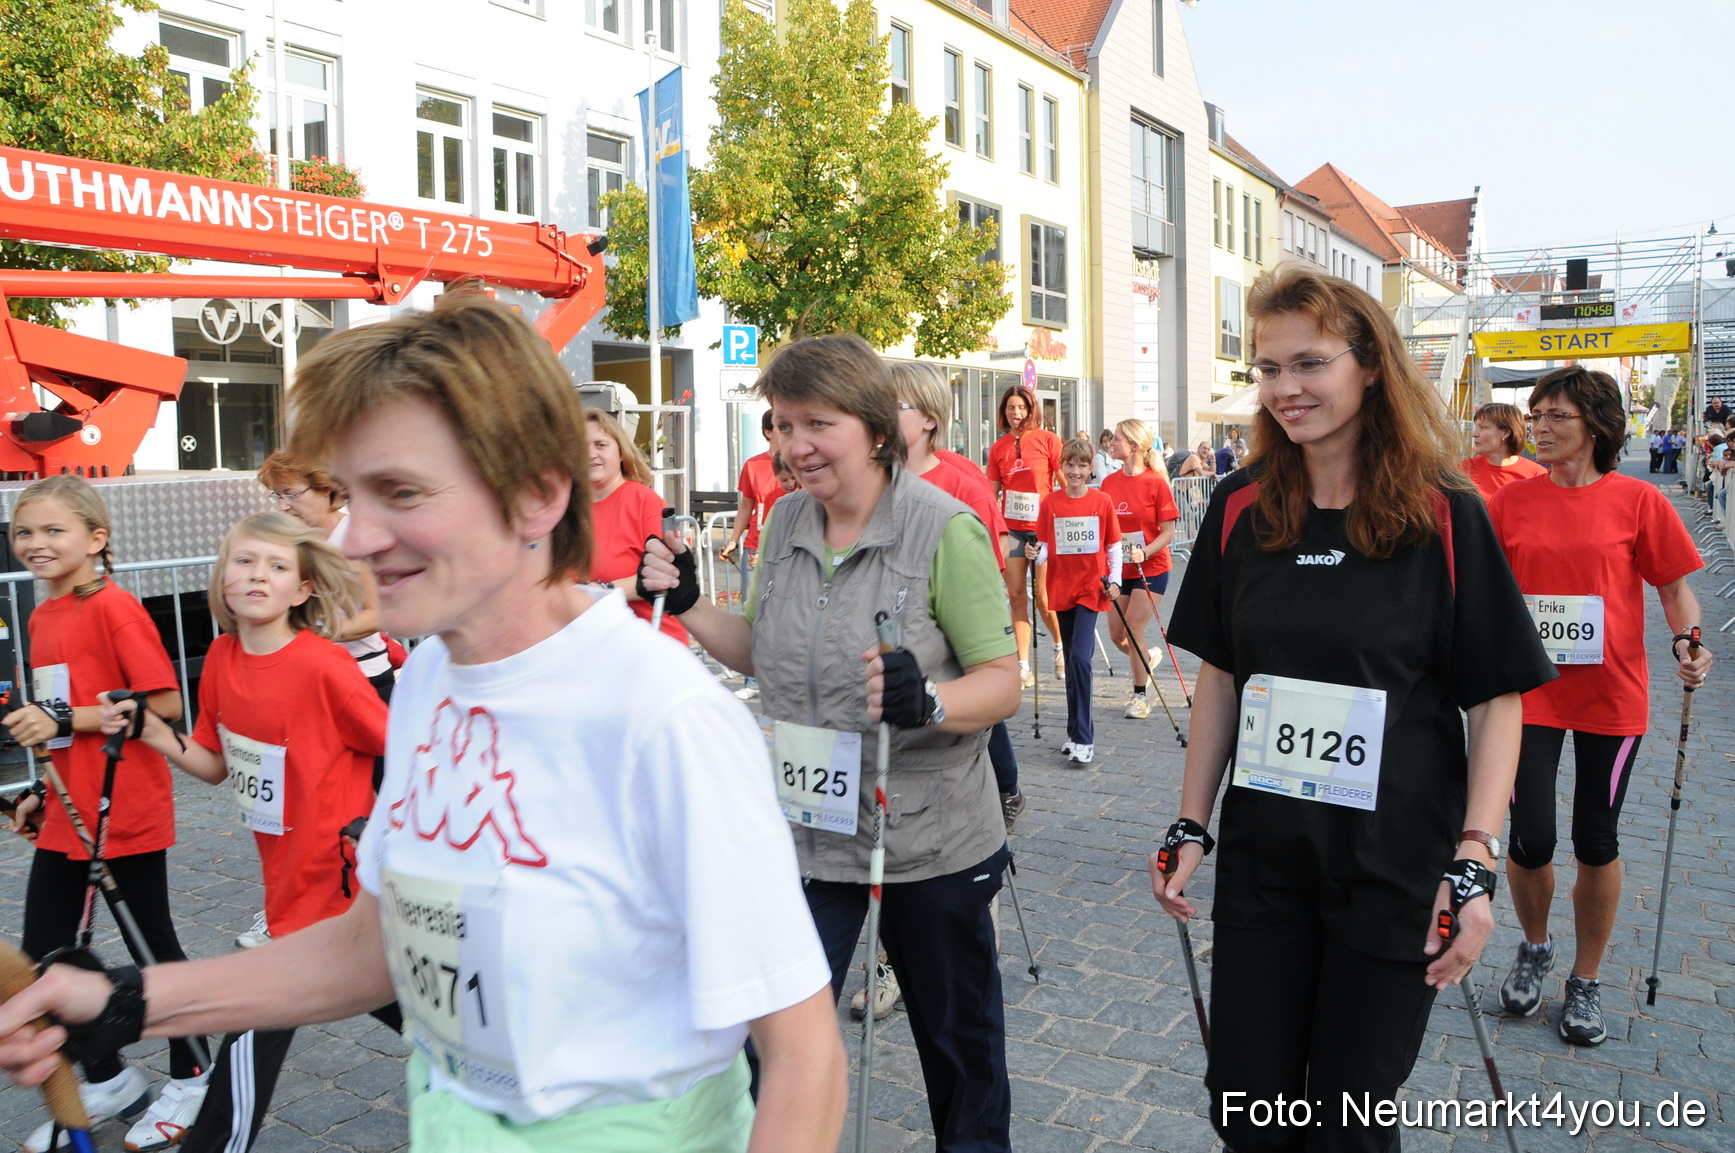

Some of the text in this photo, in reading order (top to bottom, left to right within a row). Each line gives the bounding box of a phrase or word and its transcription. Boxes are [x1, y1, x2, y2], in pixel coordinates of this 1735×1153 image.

[413, 217, 431, 250] T
[442, 221, 493, 258] 275
[729, 330, 750, 361] P
[1540, 332, 1614, 351] START
[1013, 502, 1035, 511] 8061
[1066, 530, 1095, 541] 8058
[1295, 555, 1336, 566] JAKO
[1538, 600, 1565, 613] Erika
[1539, 621, 1595, 641] 8069
[1246, 715, 1255, 731] N
[1276, 723, 1367, 766] 8126
[782, 761, 848, 798] 8125
[1317, 784, 1373, 801] PFLEIDERER
